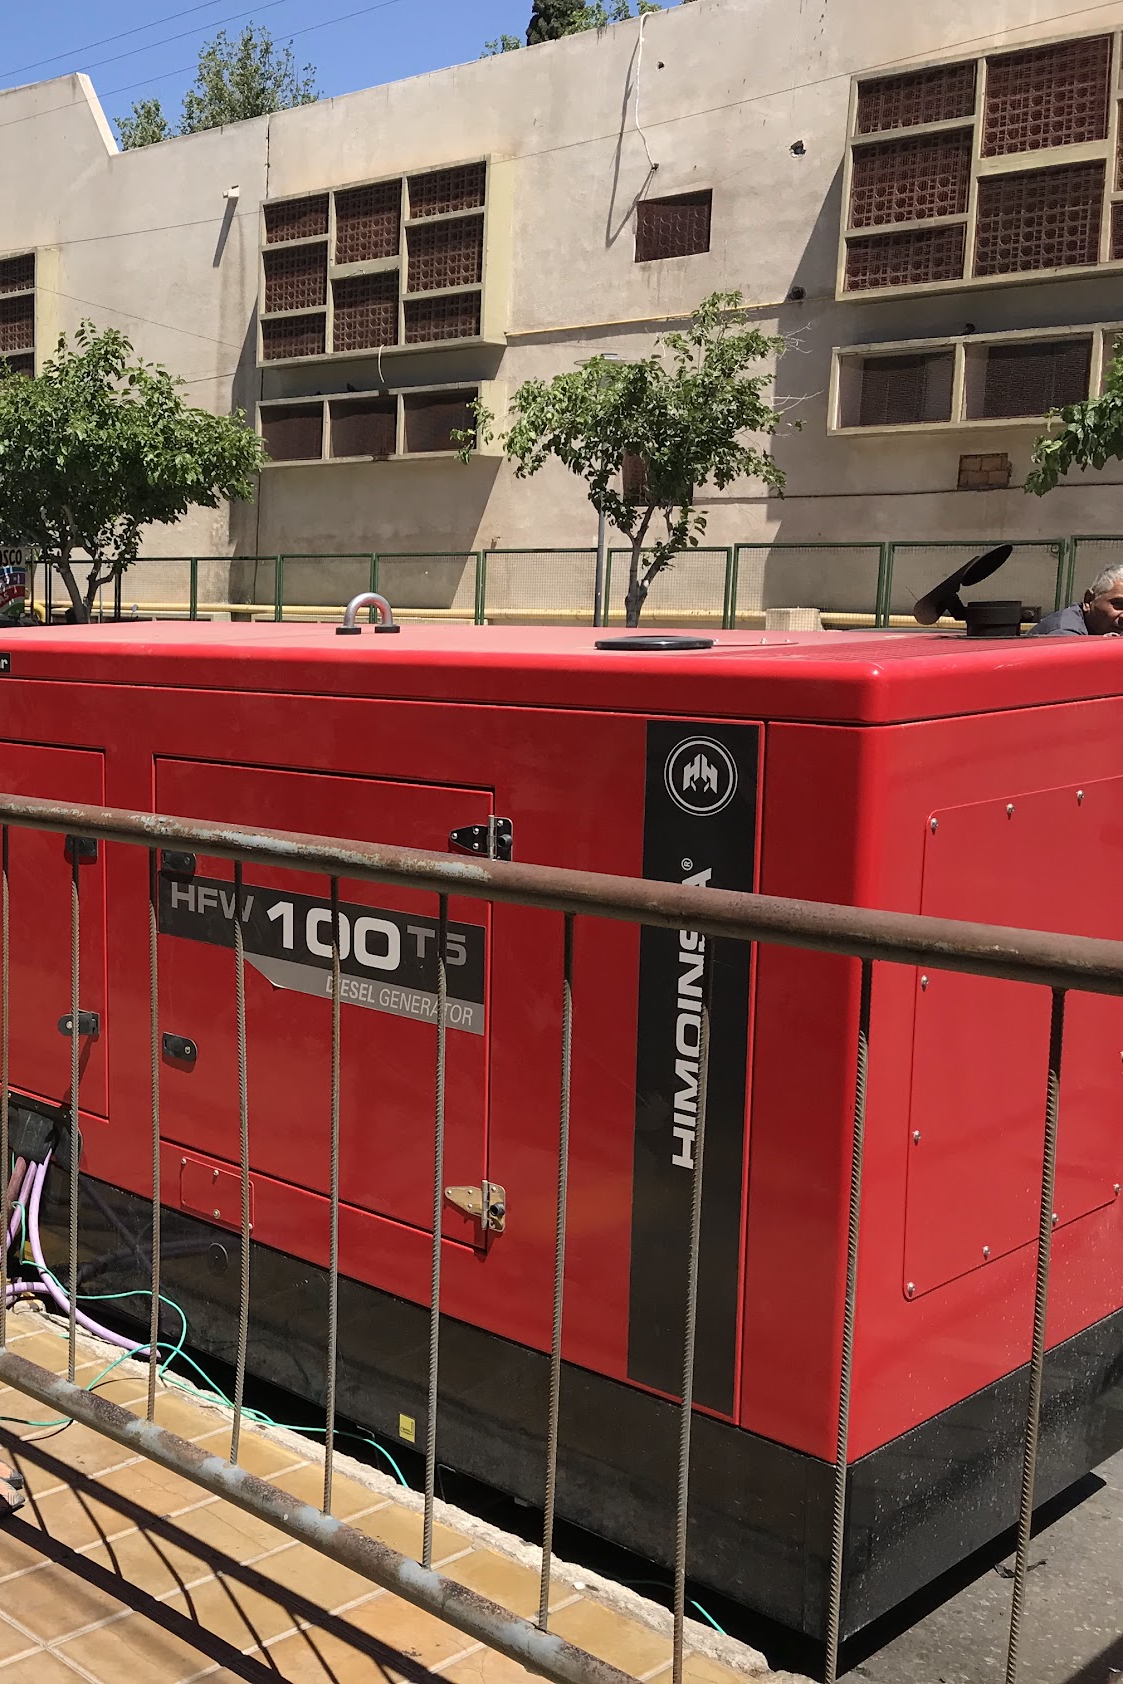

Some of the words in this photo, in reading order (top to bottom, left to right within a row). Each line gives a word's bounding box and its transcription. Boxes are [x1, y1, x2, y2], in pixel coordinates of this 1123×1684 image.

[171, 881, 255, 923] HFW
[266, 900, 401, 971] 100
[325, 975, 375, 1003] DESEL
